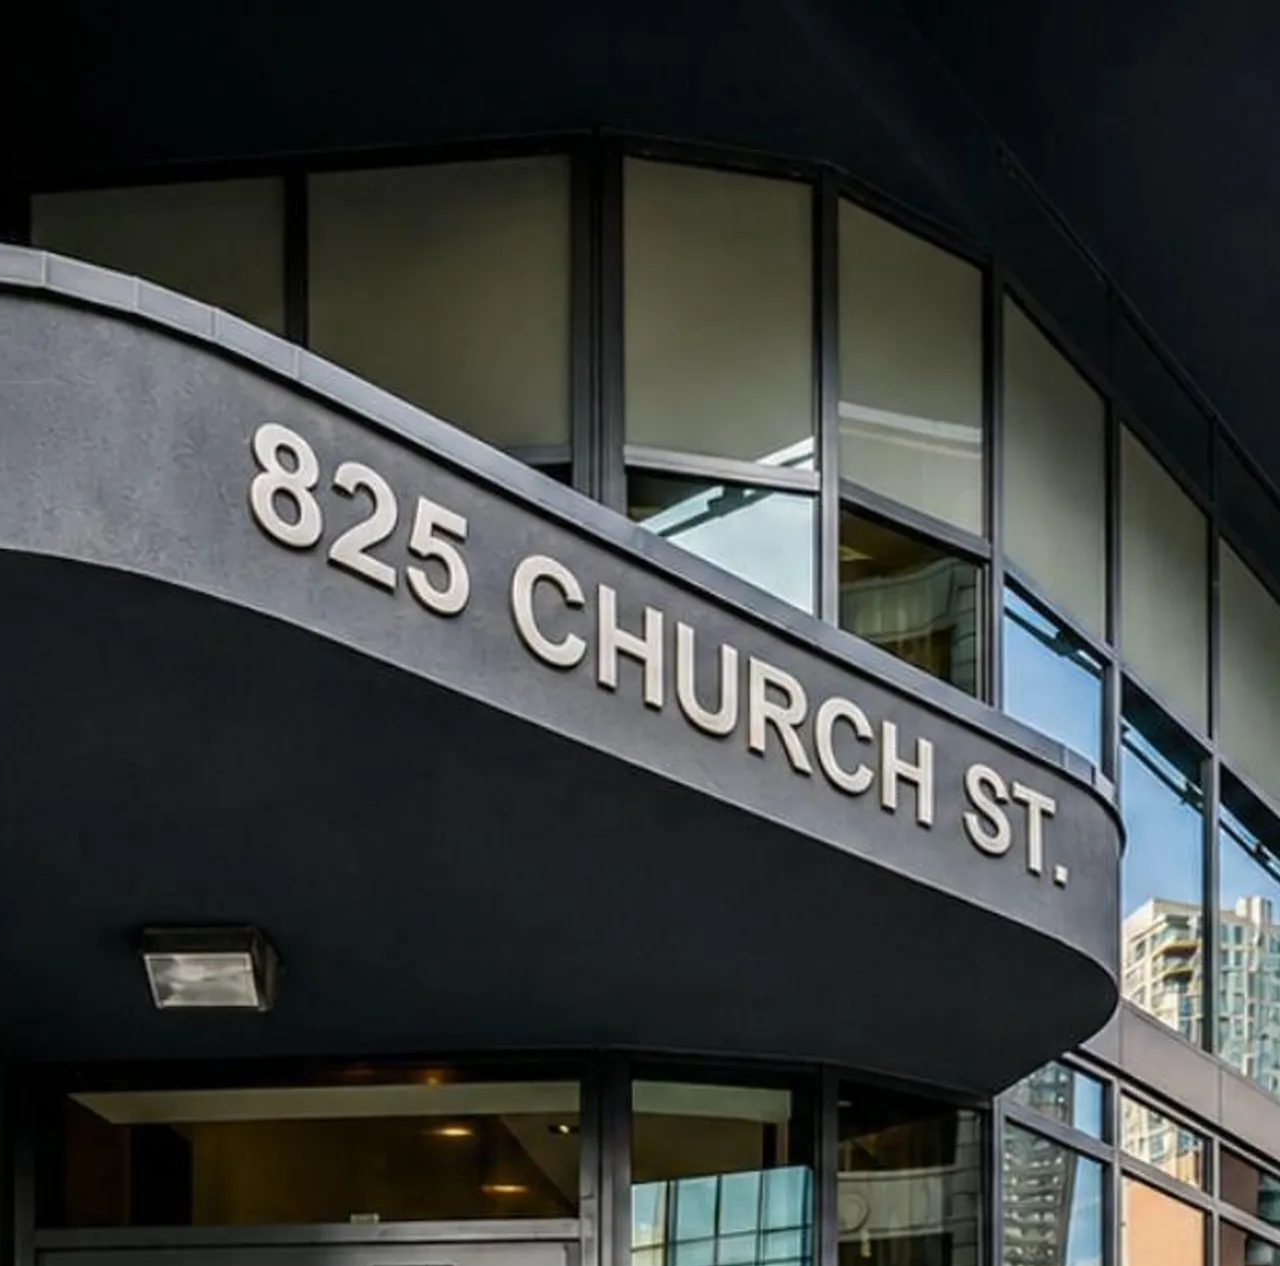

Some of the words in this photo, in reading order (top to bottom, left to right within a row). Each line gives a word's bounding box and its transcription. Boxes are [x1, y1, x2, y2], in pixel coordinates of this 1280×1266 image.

[248, 421, 472, 617] 825
[511, 553, 935, 828] CHURCH
[962, 761, 1071, 888] ST.
